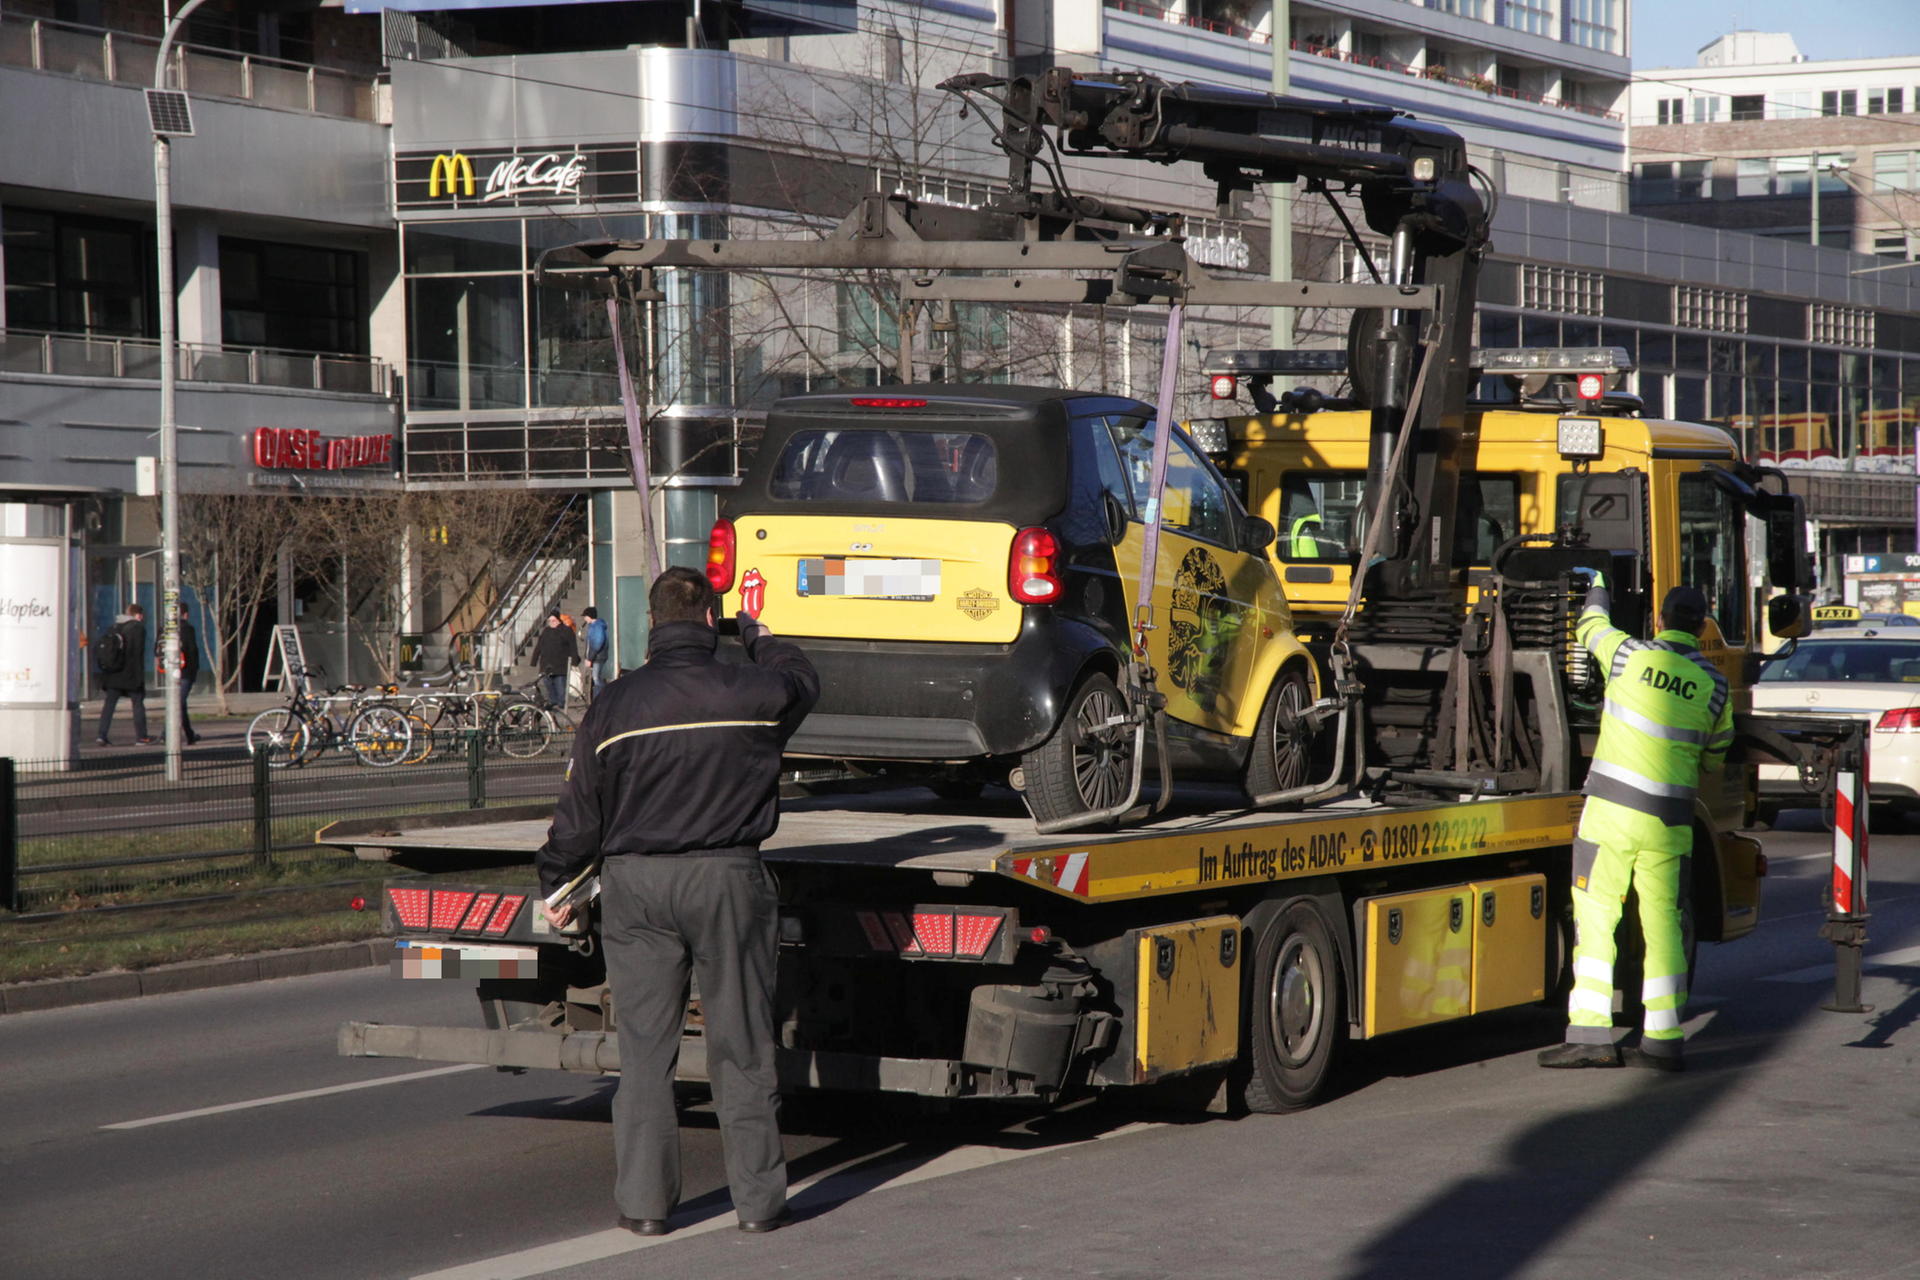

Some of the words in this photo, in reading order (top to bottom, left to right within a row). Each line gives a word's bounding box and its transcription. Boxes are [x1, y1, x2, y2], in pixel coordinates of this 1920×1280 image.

[484, 153, 587, 201] McCafé
[255, 426, 321, 469] OASE
[327, 434, 393, 470] DELUXE
[1815, 608, 1853, 618] TAXI
[1638, 666, 1698, 700] ADAC
[1198, 847, 1217, 884] Im
[1222, 841, 1278, 881] Auftrag
[1281, 838, 1306, 872] des
[1308, 831, 1347, 868] ADAC
[1382, 825, 1418, 861] 0180
